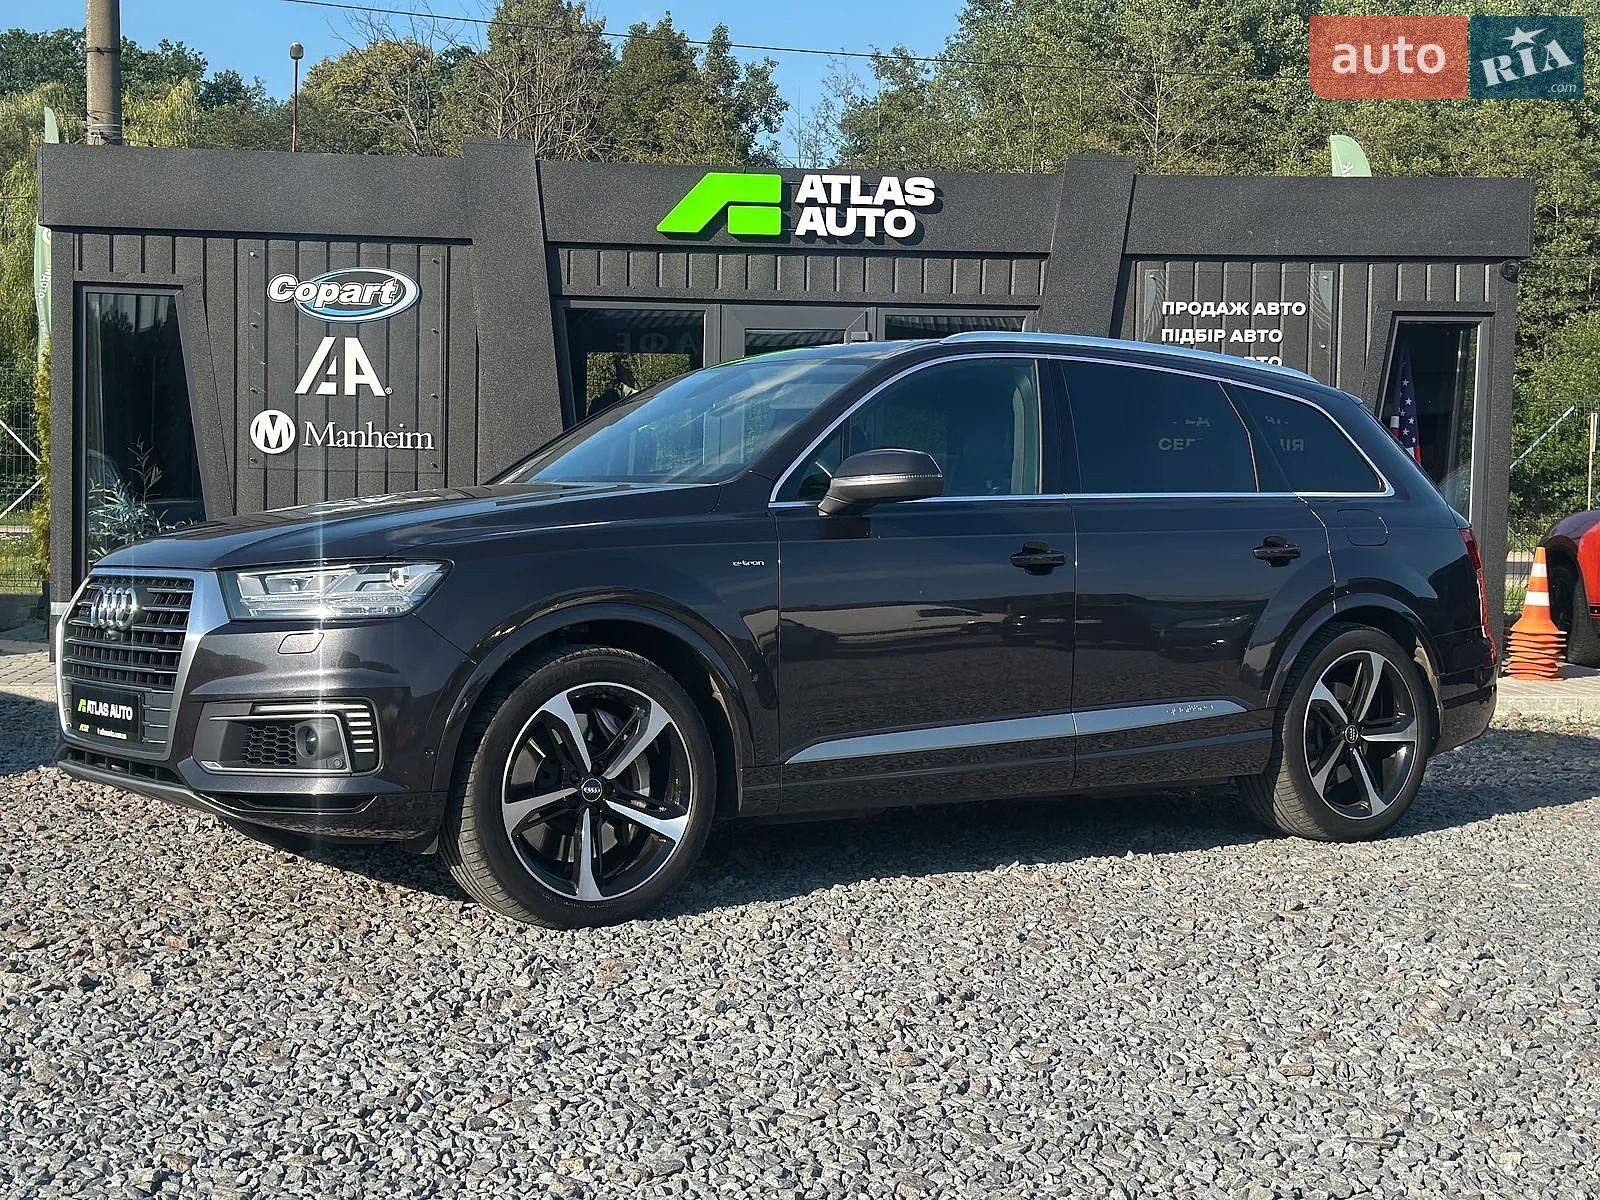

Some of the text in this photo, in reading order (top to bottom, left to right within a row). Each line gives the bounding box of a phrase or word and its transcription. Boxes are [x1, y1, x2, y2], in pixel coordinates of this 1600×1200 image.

[795, 174, 936, 207] ATLAS
[795, 207, 917, 239] AUTO
[267, 273, 400, 309] Copart
[1162, 301, 1307, 317] ПРОДАЖ АВТО
[1161, 329, 1283, 344] ПІДБІР АВТО
[302, 421, 435, 450] Manheim
[732, 559, 765, 567] e-tron
[86, 699, 133, 721] ATLAS AUTO
